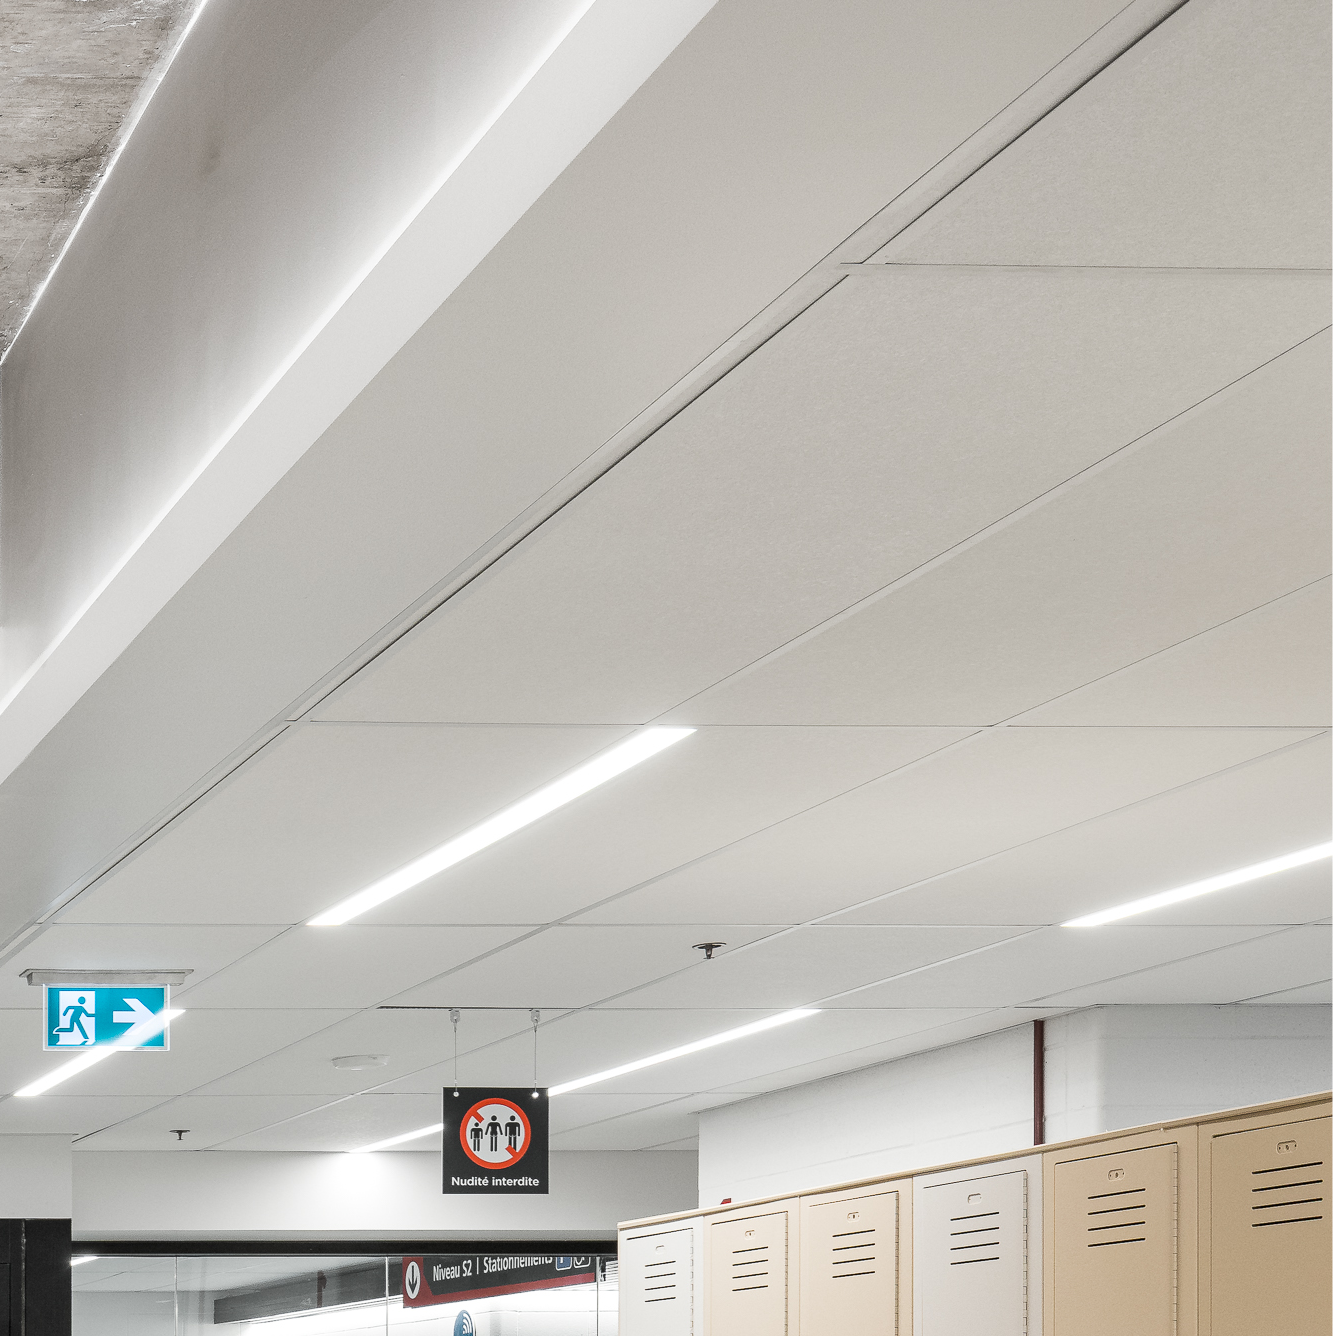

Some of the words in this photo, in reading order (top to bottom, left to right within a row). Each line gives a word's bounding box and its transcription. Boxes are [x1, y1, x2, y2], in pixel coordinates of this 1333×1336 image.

[451, 1176, 489, 1186] Nudité
[492, 1176, 540, 1186] interdite
[433, 1264, 461, 1282] Niveau
[462, 1260, 473, 1276] S2
